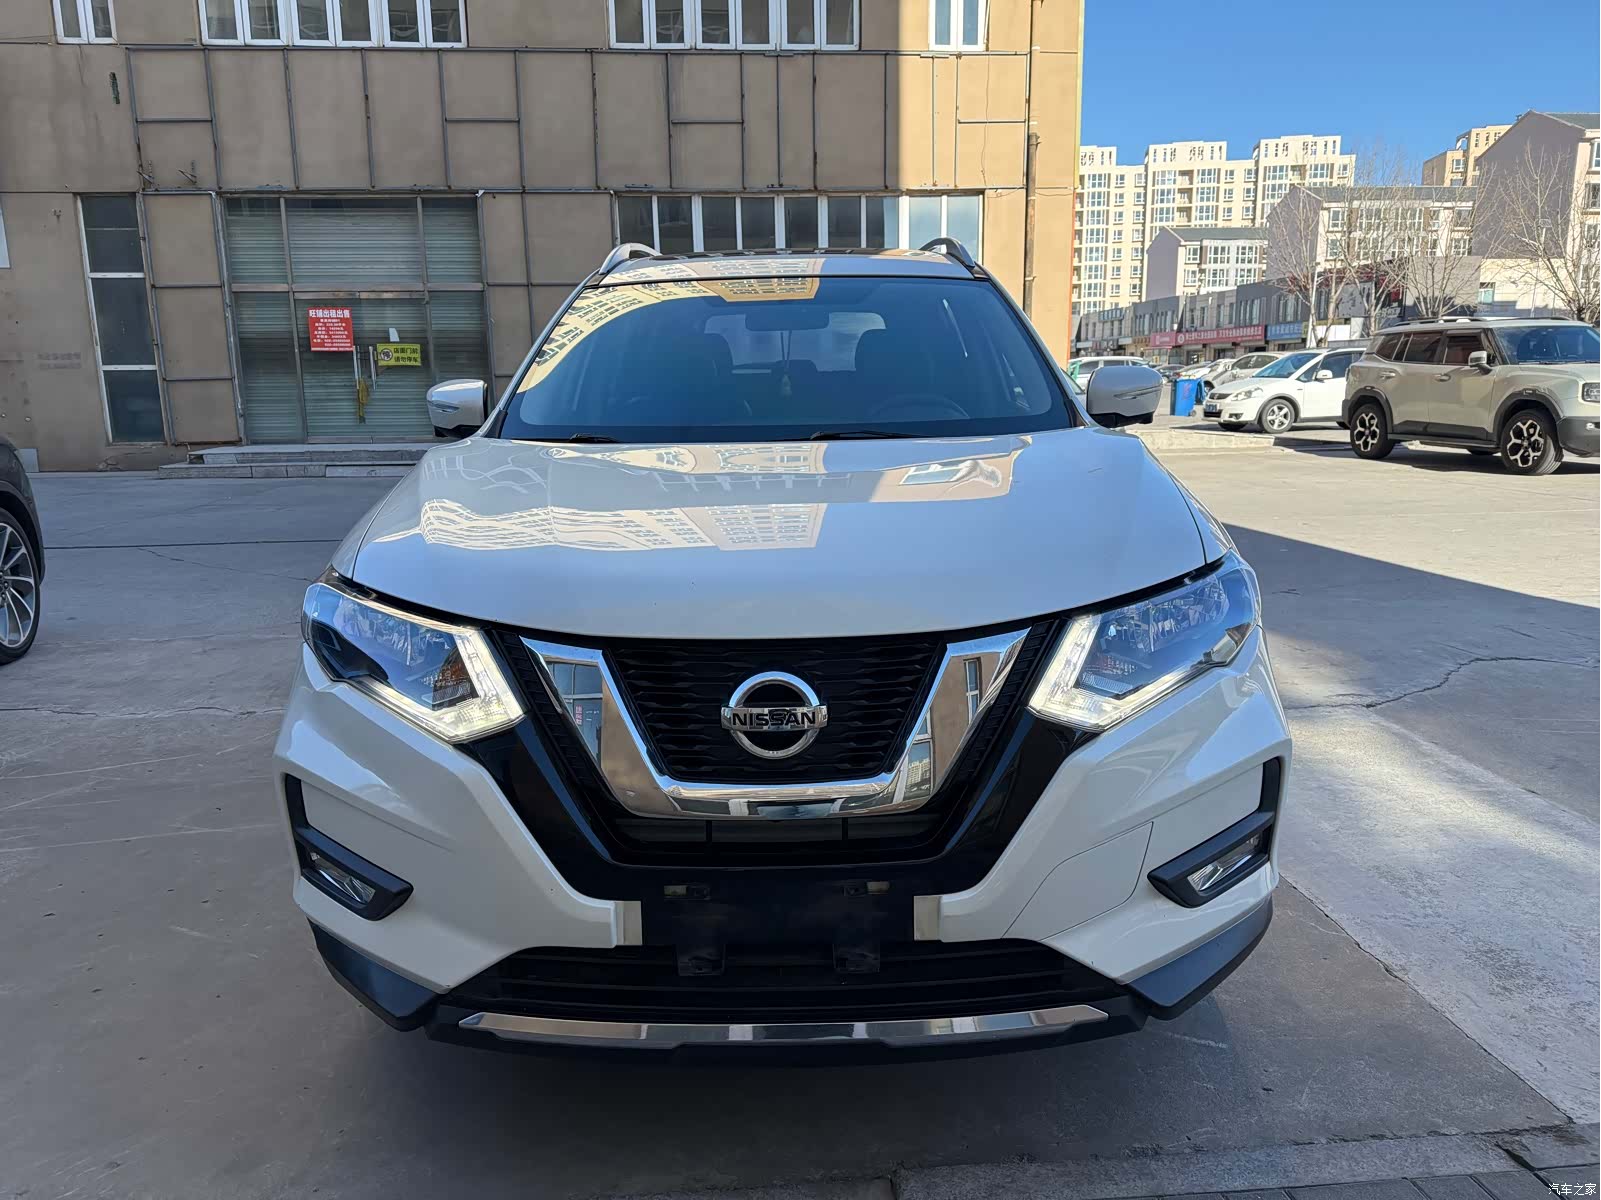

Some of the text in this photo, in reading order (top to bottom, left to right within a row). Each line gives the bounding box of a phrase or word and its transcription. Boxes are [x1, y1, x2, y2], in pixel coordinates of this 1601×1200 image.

[309, 309, 350, 318] 旺铺出租出售
[732, 710, 816, 727] NISSAN
